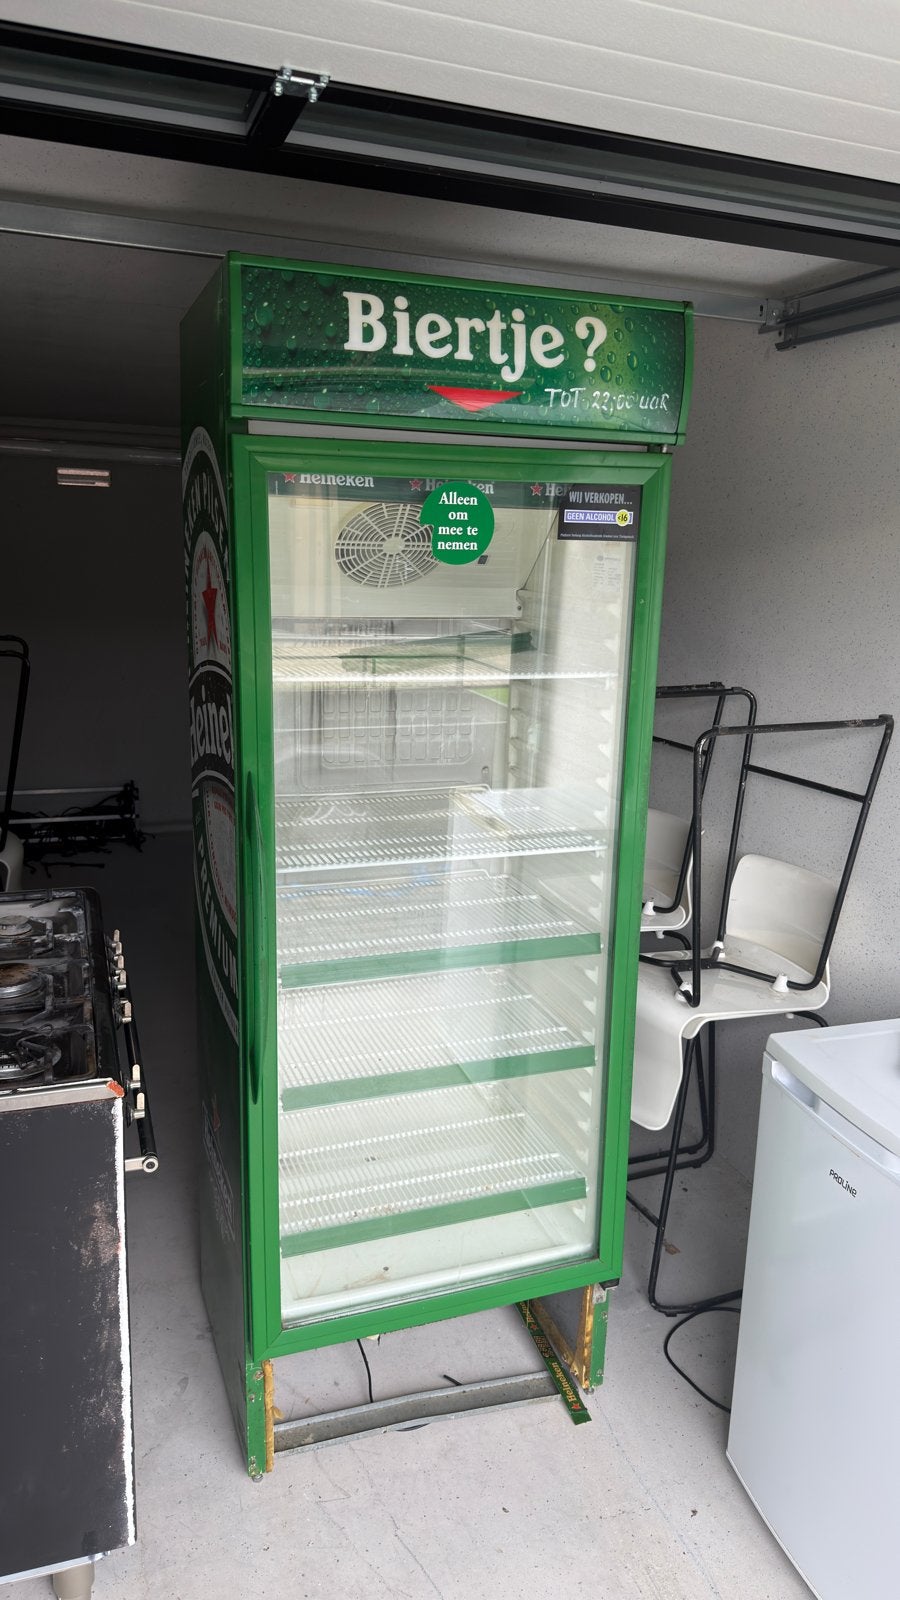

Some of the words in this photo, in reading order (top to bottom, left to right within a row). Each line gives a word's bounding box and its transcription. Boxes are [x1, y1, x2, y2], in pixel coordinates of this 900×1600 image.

[342, 291, 565, 383] Biertje
[574, 316, 608, 373] ?
[544, 387, 586, 408] TOT
[438, 491, 479, 506] Alleen
[568, 491, 583, 504] WIJ
[448, 511, 469, 521] om
[566, 512, 585, 521] GEEN
[585, 512, 615, 522] ALCOHOL
[438, 526, 463, 535] mee
[467, 525, 479, 536] te
[437, 541, 478, 551] nemen
[551, 1362, 577, 1402] Heineken
